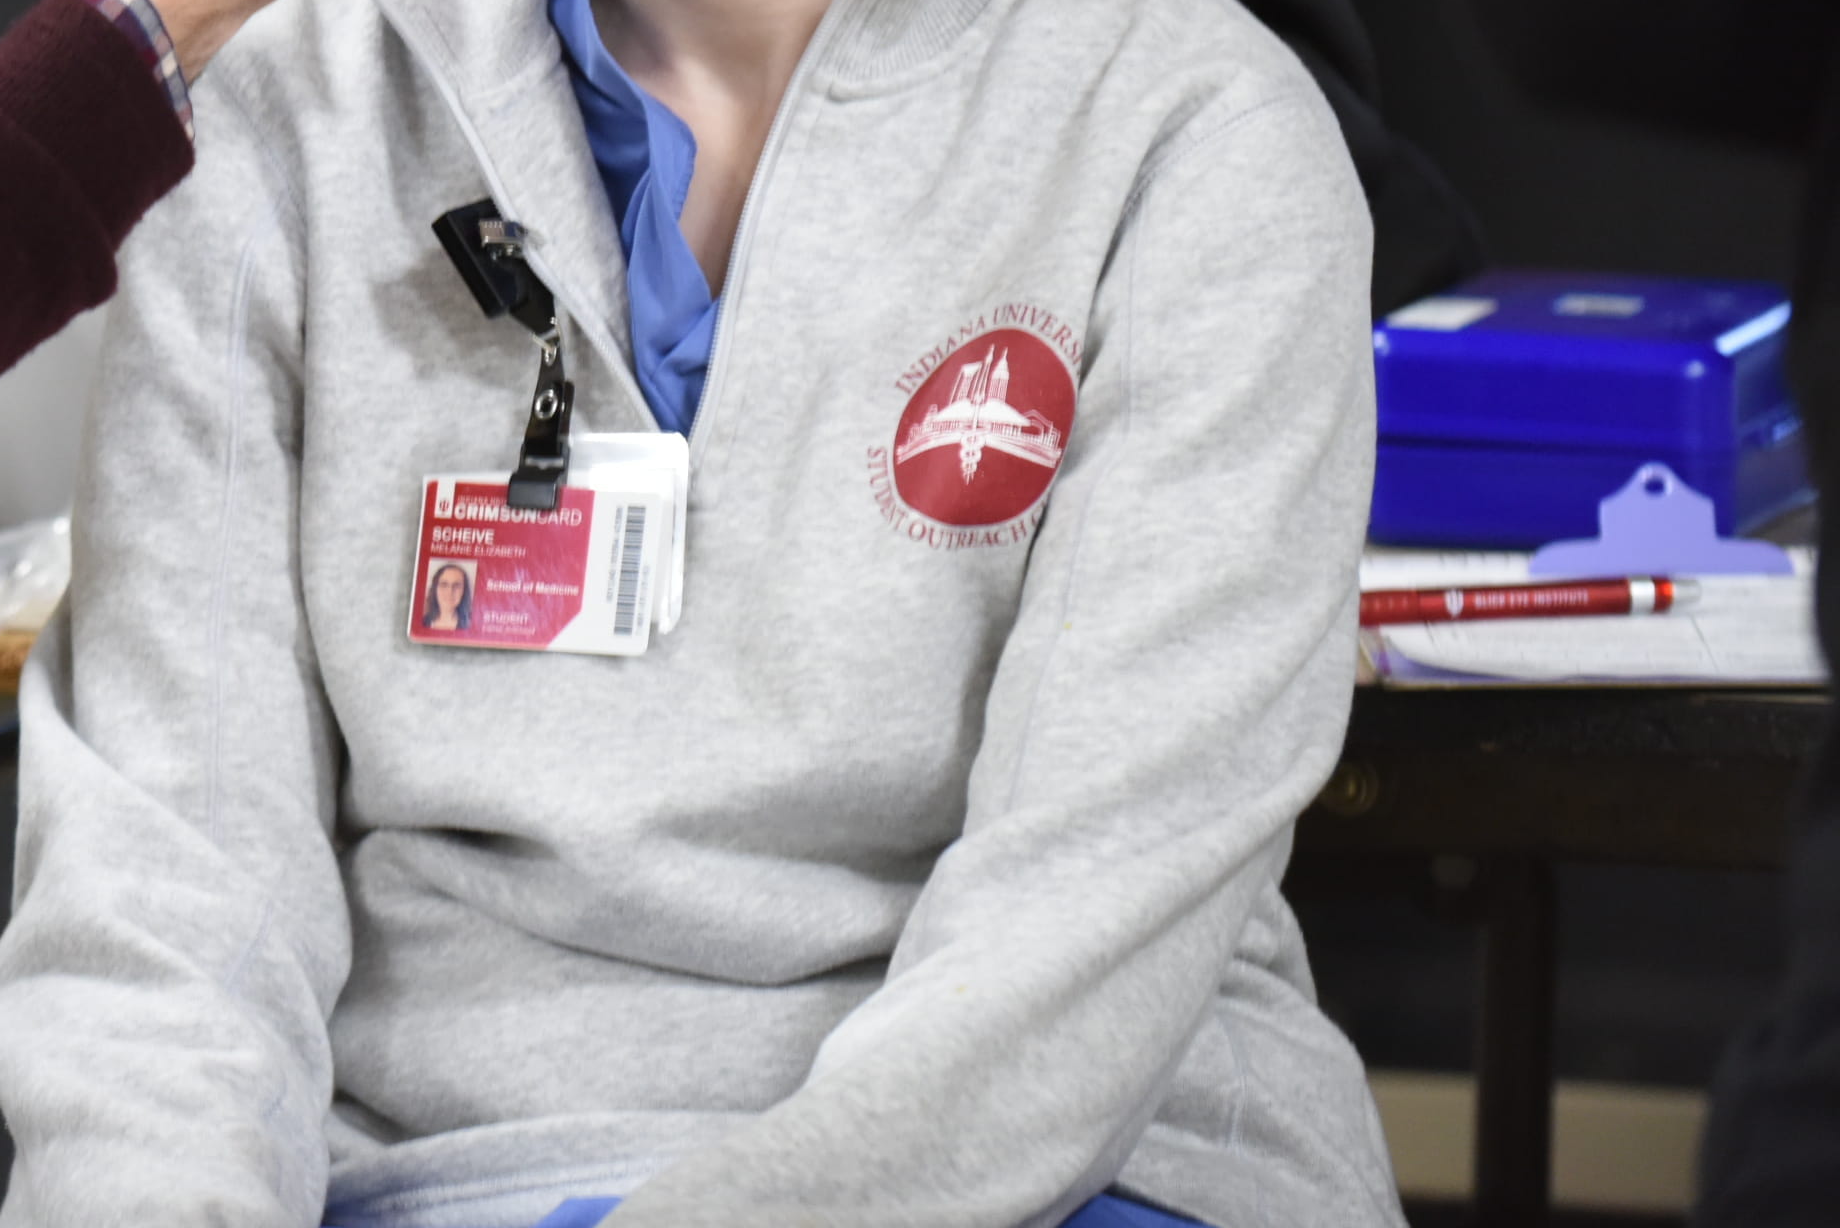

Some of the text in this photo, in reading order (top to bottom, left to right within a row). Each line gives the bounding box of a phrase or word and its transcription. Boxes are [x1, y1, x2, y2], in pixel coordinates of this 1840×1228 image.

[894, 303, 1083, 394] INDIANA UNIVERSI
[432, 526, 495, 545] SCHEIVE
[908, 520, 1028, 550] OUTREACH
[474, 544, 526, 558] ELIZABETH
